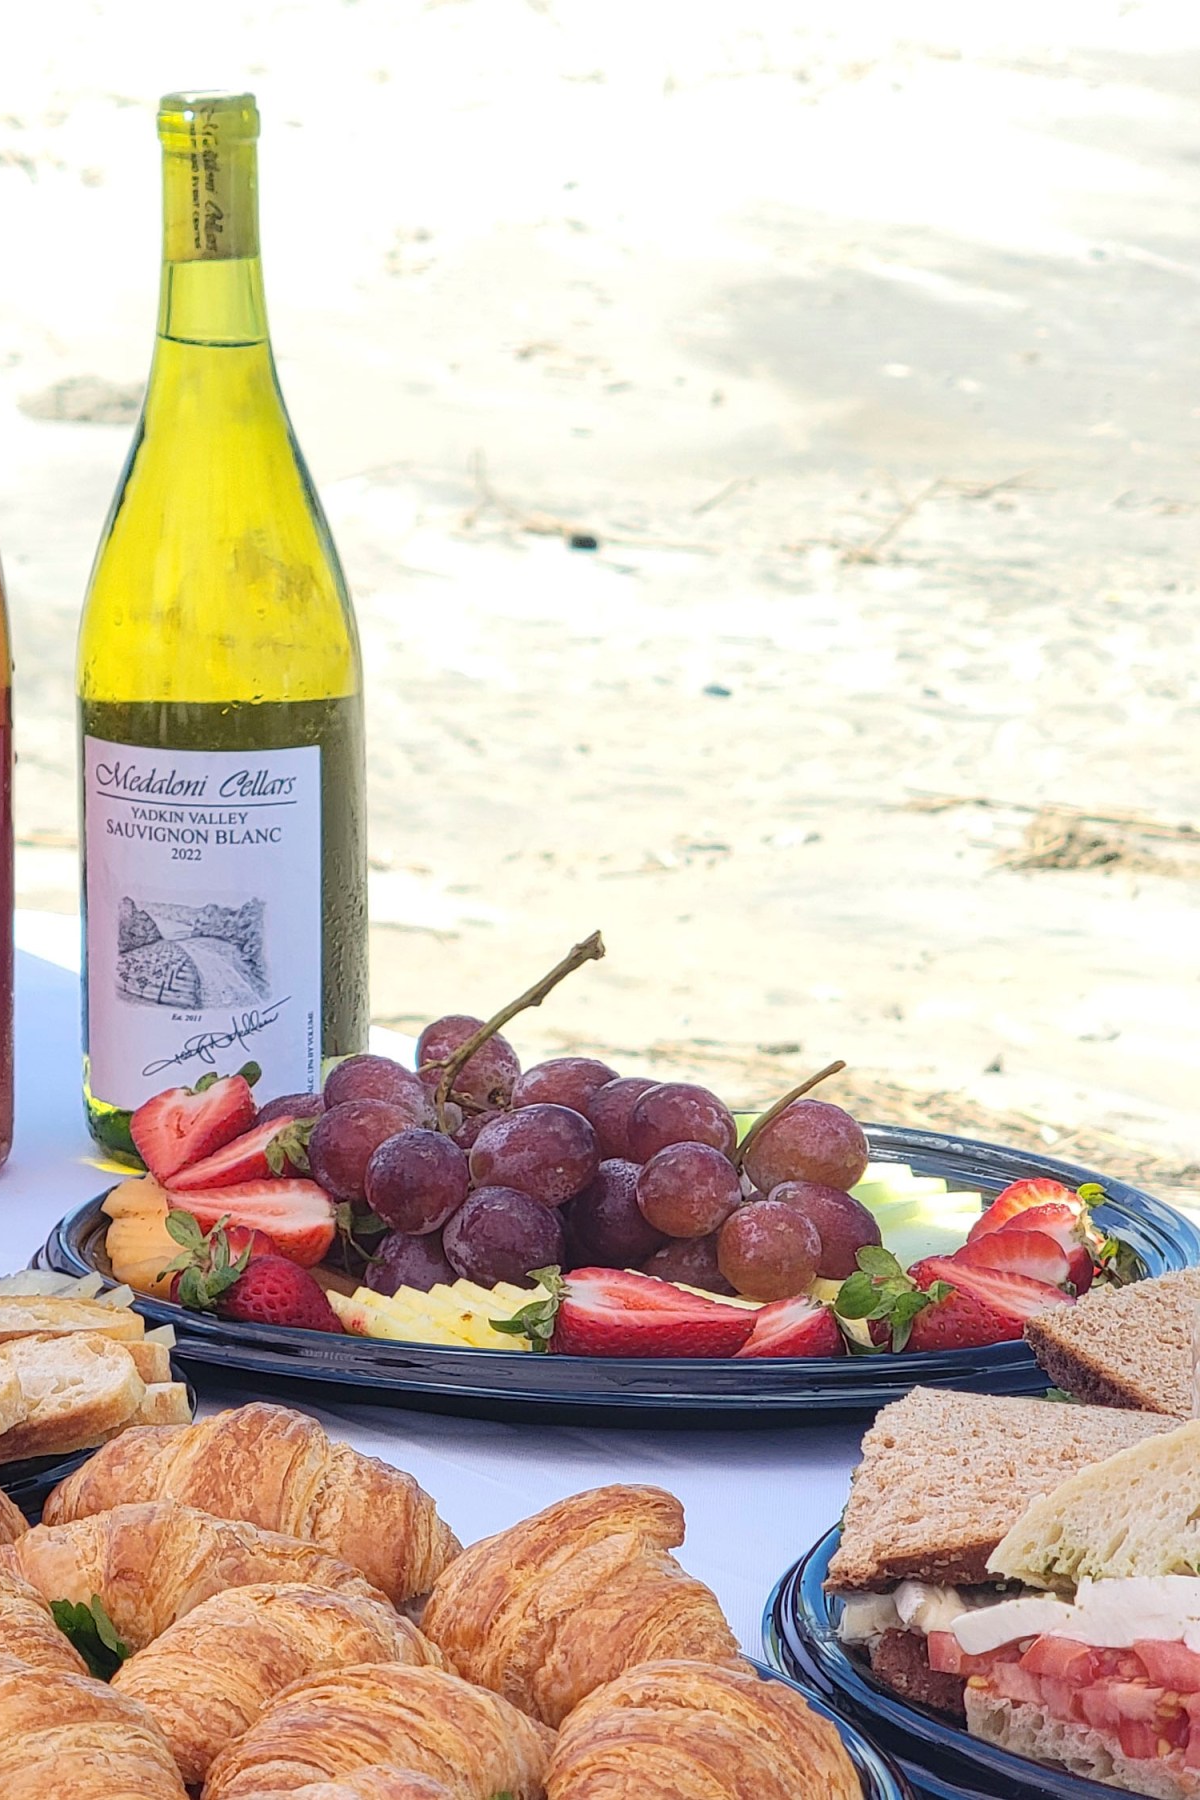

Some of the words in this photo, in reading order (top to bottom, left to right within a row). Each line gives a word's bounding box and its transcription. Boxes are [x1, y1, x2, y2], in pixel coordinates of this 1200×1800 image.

[95, 761, 209, 797] Medaloni
[219, 769, 297, 798] Cellars
[130, 806, 184, 823] YADKIN
[189, 811, 249, 825] VALLEY
[106, 819, 209, 845] SAUVIGNON
[215, 826, 282, 845] BLANC
[171, 848, 202, 861] 2022
